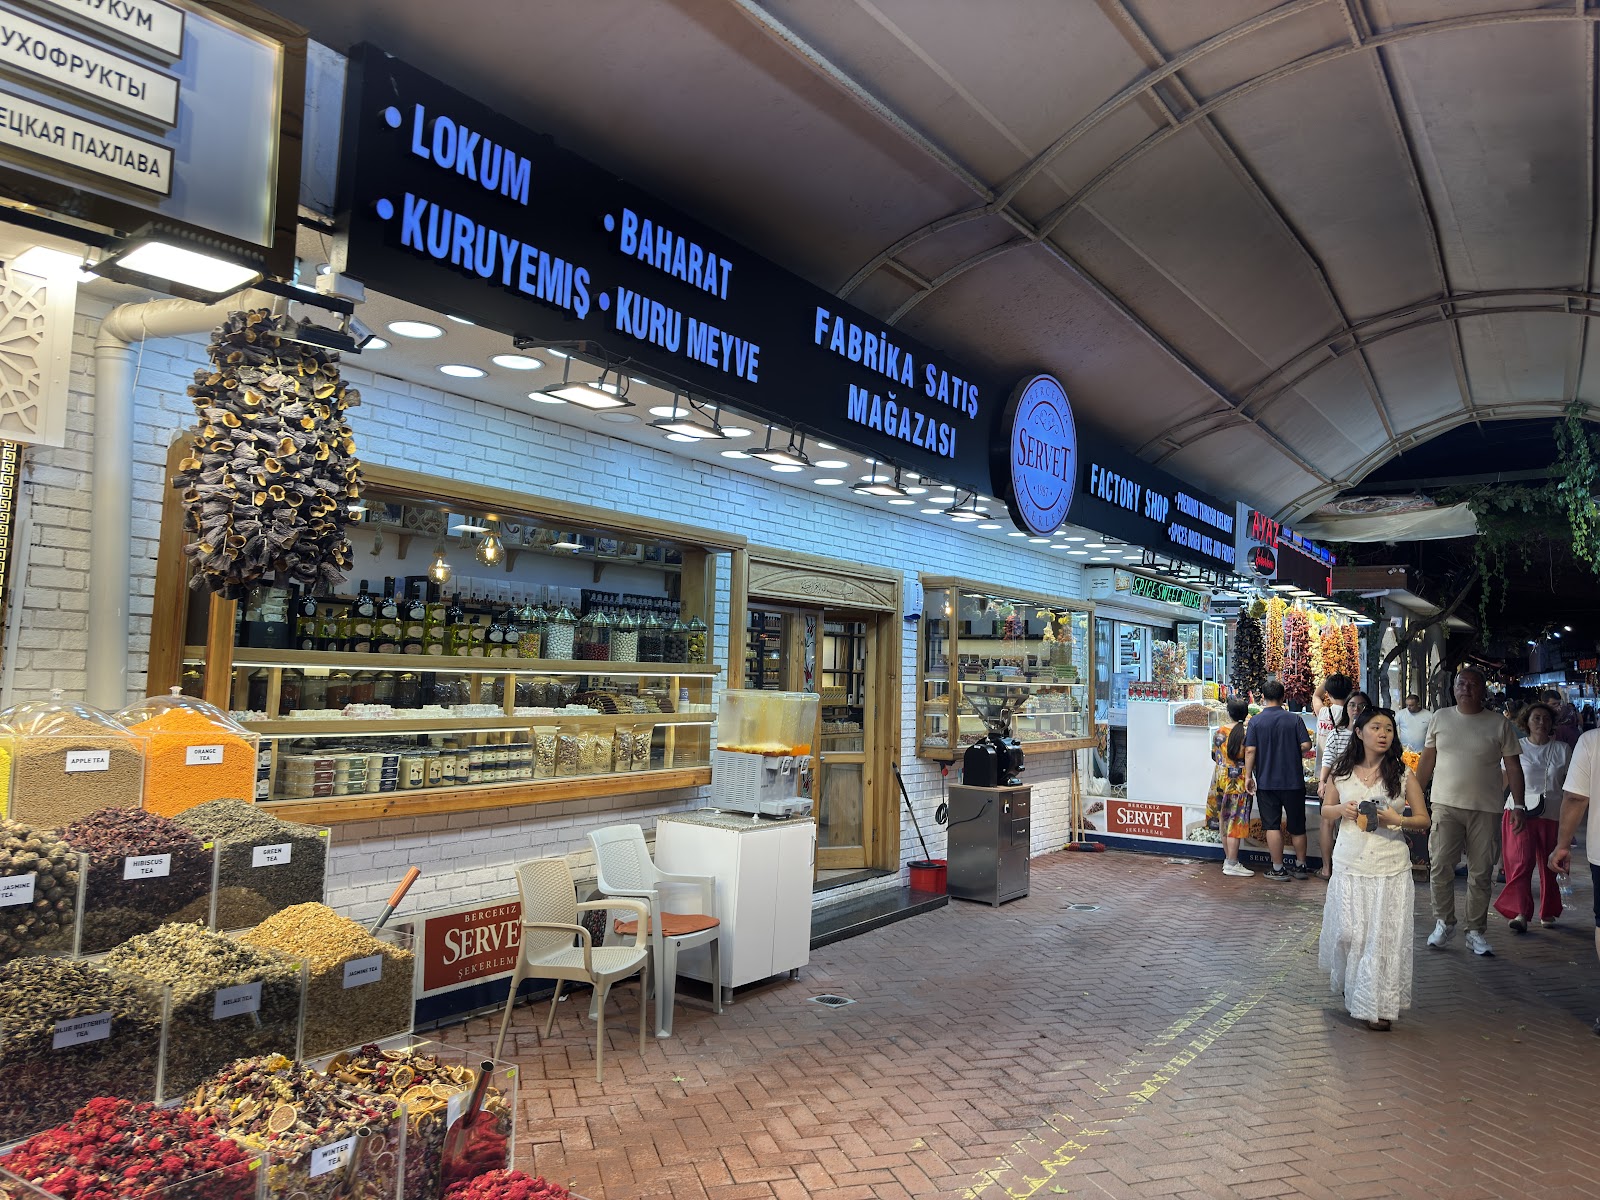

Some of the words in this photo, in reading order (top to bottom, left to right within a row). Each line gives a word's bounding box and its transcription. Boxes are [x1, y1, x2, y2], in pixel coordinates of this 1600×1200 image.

[71, 131, 161, 178] ПАХЛАВА
[411, 103, 532, 206] LOKUM
[400, 191, 591, 320] KURUYEMIŞ
[619, 207, 733, 300] BAHARAT
[615, 286, 682, 353] KURU
[686, 316, 760, 383] MEYVE
[814, 306, 914, 389] FABRİKA
[925, 363, 979, 420] SATIŞ
[847, 383, 956, 459] MAĞAZASI
[1017, 427, 1071, 482] SERVET
[1090, 462, 1141, 513] FACTORY
[1144, 488, 1169, 524] SHOP
[1177, 491, 1199, 519] PREMIUM
[1170, 521, 1188, 547] SPICES
[1187, 528, 1201, 551] DRIED
[1201, 534, 1213, 557] NUTS
[1252, 510, 1280, 549] AYAZ
[1132, 577, 1157, 598] SPICE
[1156, 583, 1180, 603] SWEET
[1179, 589, 1202, 609] HOUSE
[1116, 807, 1173, 829] SERVET
[132, 858, 164, 867] HIBISCUS
[1249, 854, 1273, 863] SERV
[2, 882, 31, 891] JASMINE
[464, 905, 518, 923] BERCEKIZ
[443, 915, 522, 965] SERVE
[348, 967, 368, 977] JASMINE
[55, 1025, 73, 1035] BLUE
[73, 1017, 111, 1030] BUTTERFLY
[322, 1143, 349, 1158] WINTER
[328, 1156, 341, 1166] TEA
